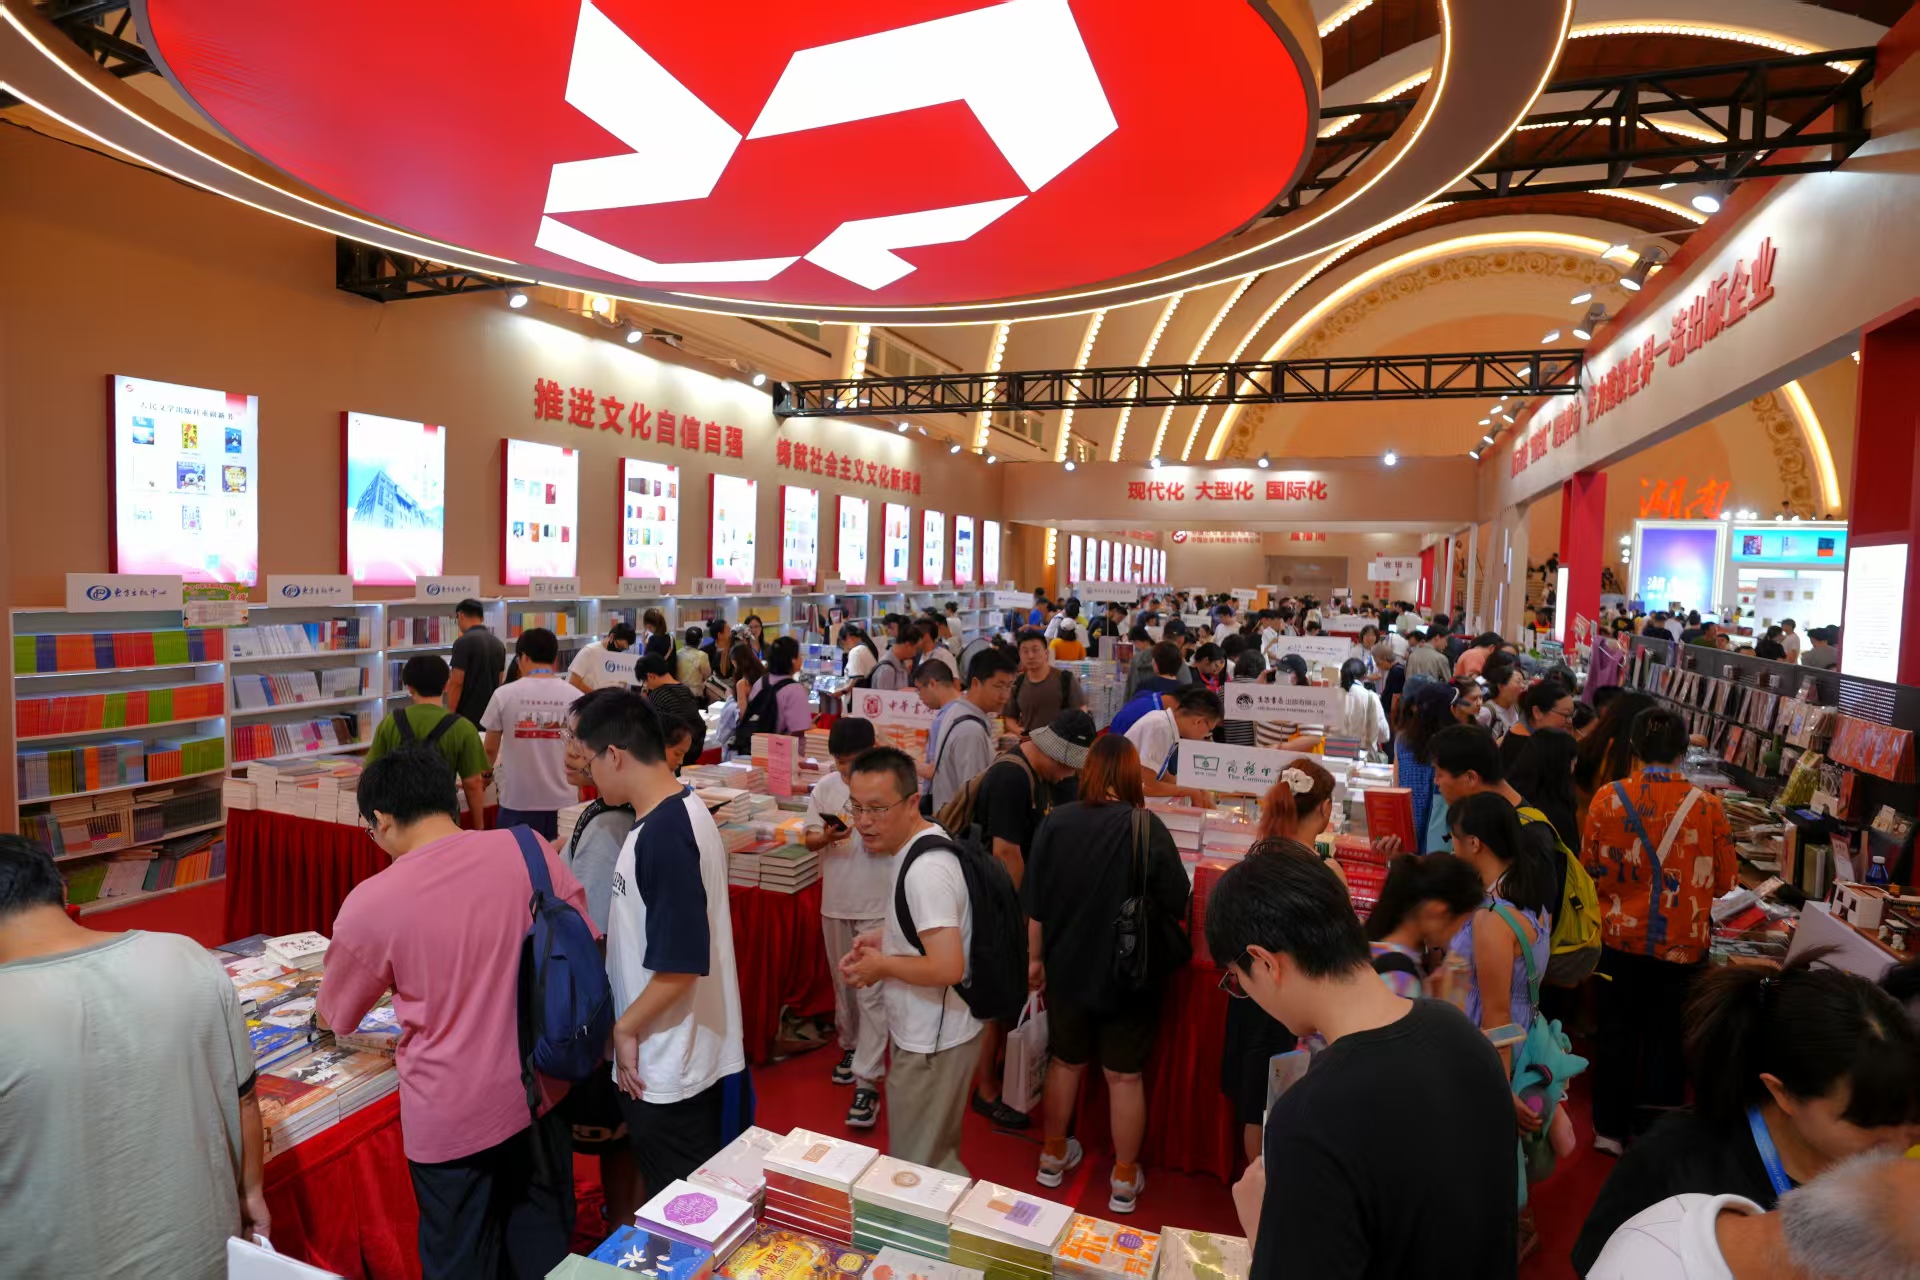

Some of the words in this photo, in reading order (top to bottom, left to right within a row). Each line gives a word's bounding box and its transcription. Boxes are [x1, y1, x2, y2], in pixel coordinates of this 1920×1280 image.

[535, 377, 744, 460] 推进文化自信自强
[776, 436, 922, 496] 铸就社会主义文化新辉煌
[1127, 481, 1185, 501] 现代化
[1195, 481, 1254, 501] 大型化
[1265, 481, 1328, 501] 国际化
